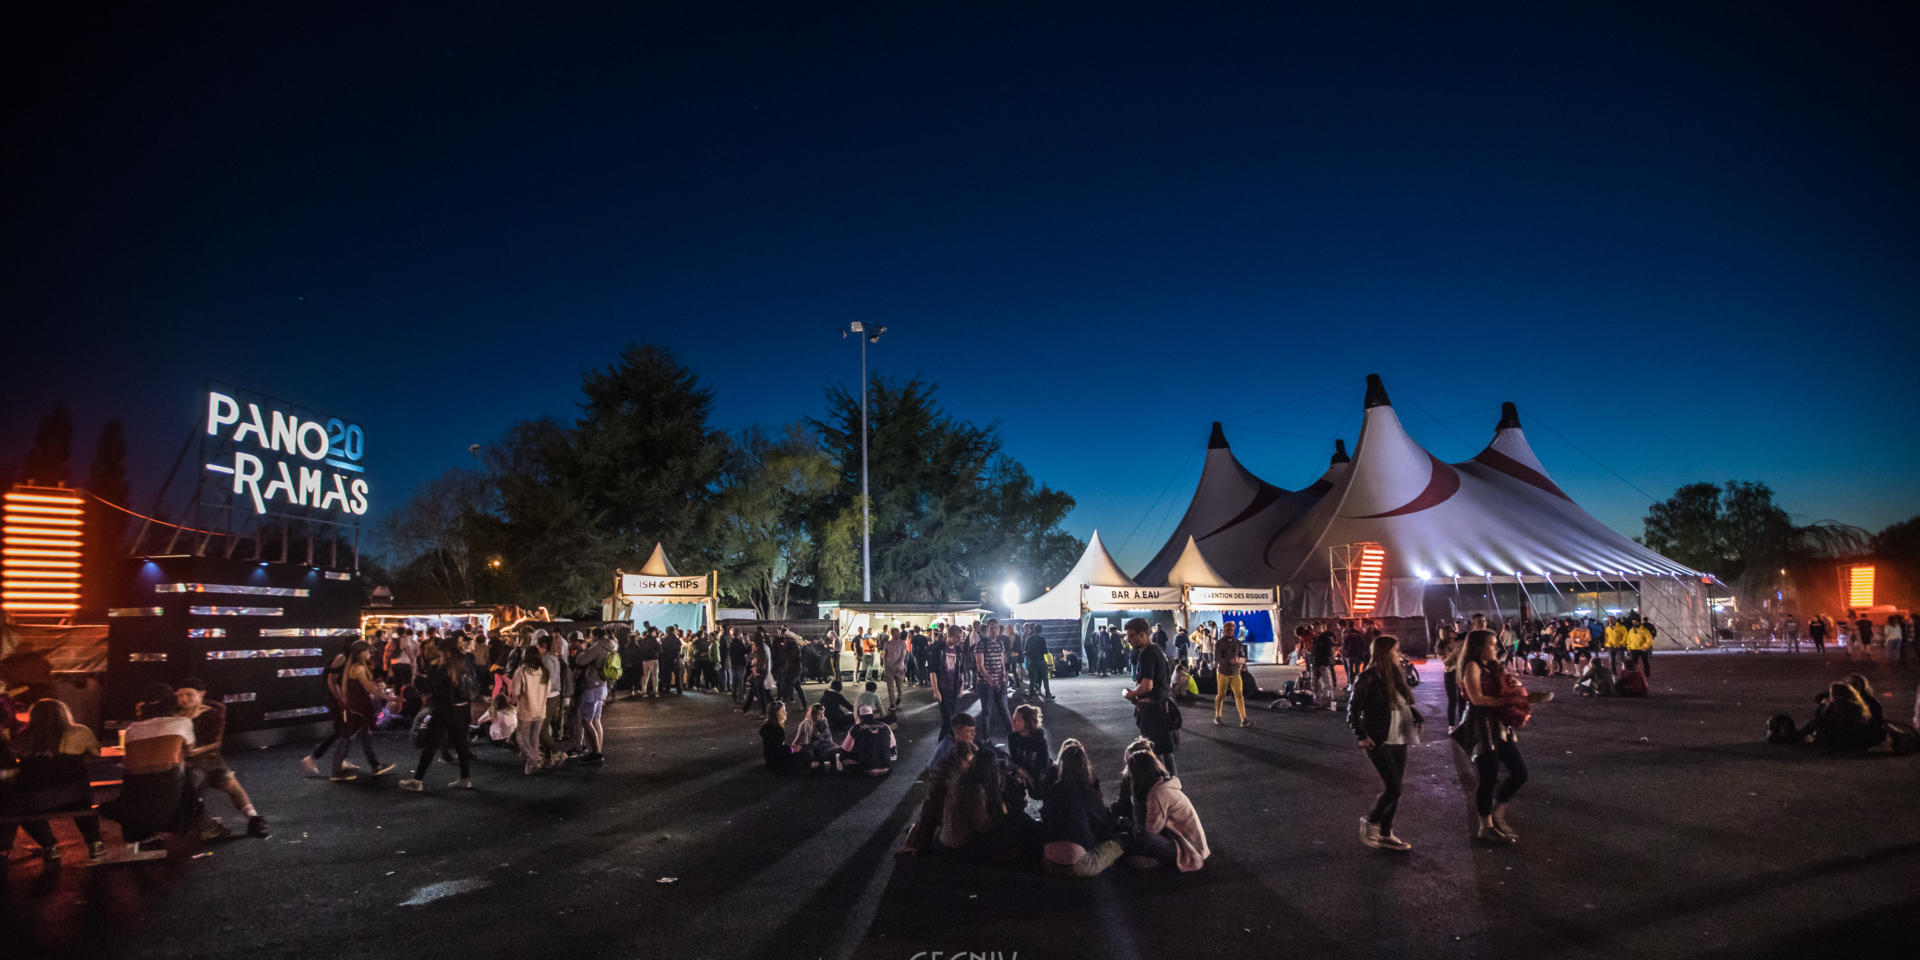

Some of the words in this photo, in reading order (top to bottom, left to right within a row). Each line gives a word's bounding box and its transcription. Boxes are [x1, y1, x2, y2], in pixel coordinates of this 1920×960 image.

[207, 391, 330, 461] PANO
[326, 418, 365, 462] 20
[632, 580, 656, 589] ISH
[658, 580, 666, 589] &
[668, 580, 699, 589] CHIPS
[1111, 590, 1130, 599] BAR
[1134, 588, 1140, 599] À
[1142, 590, 1160, 599] EAU
